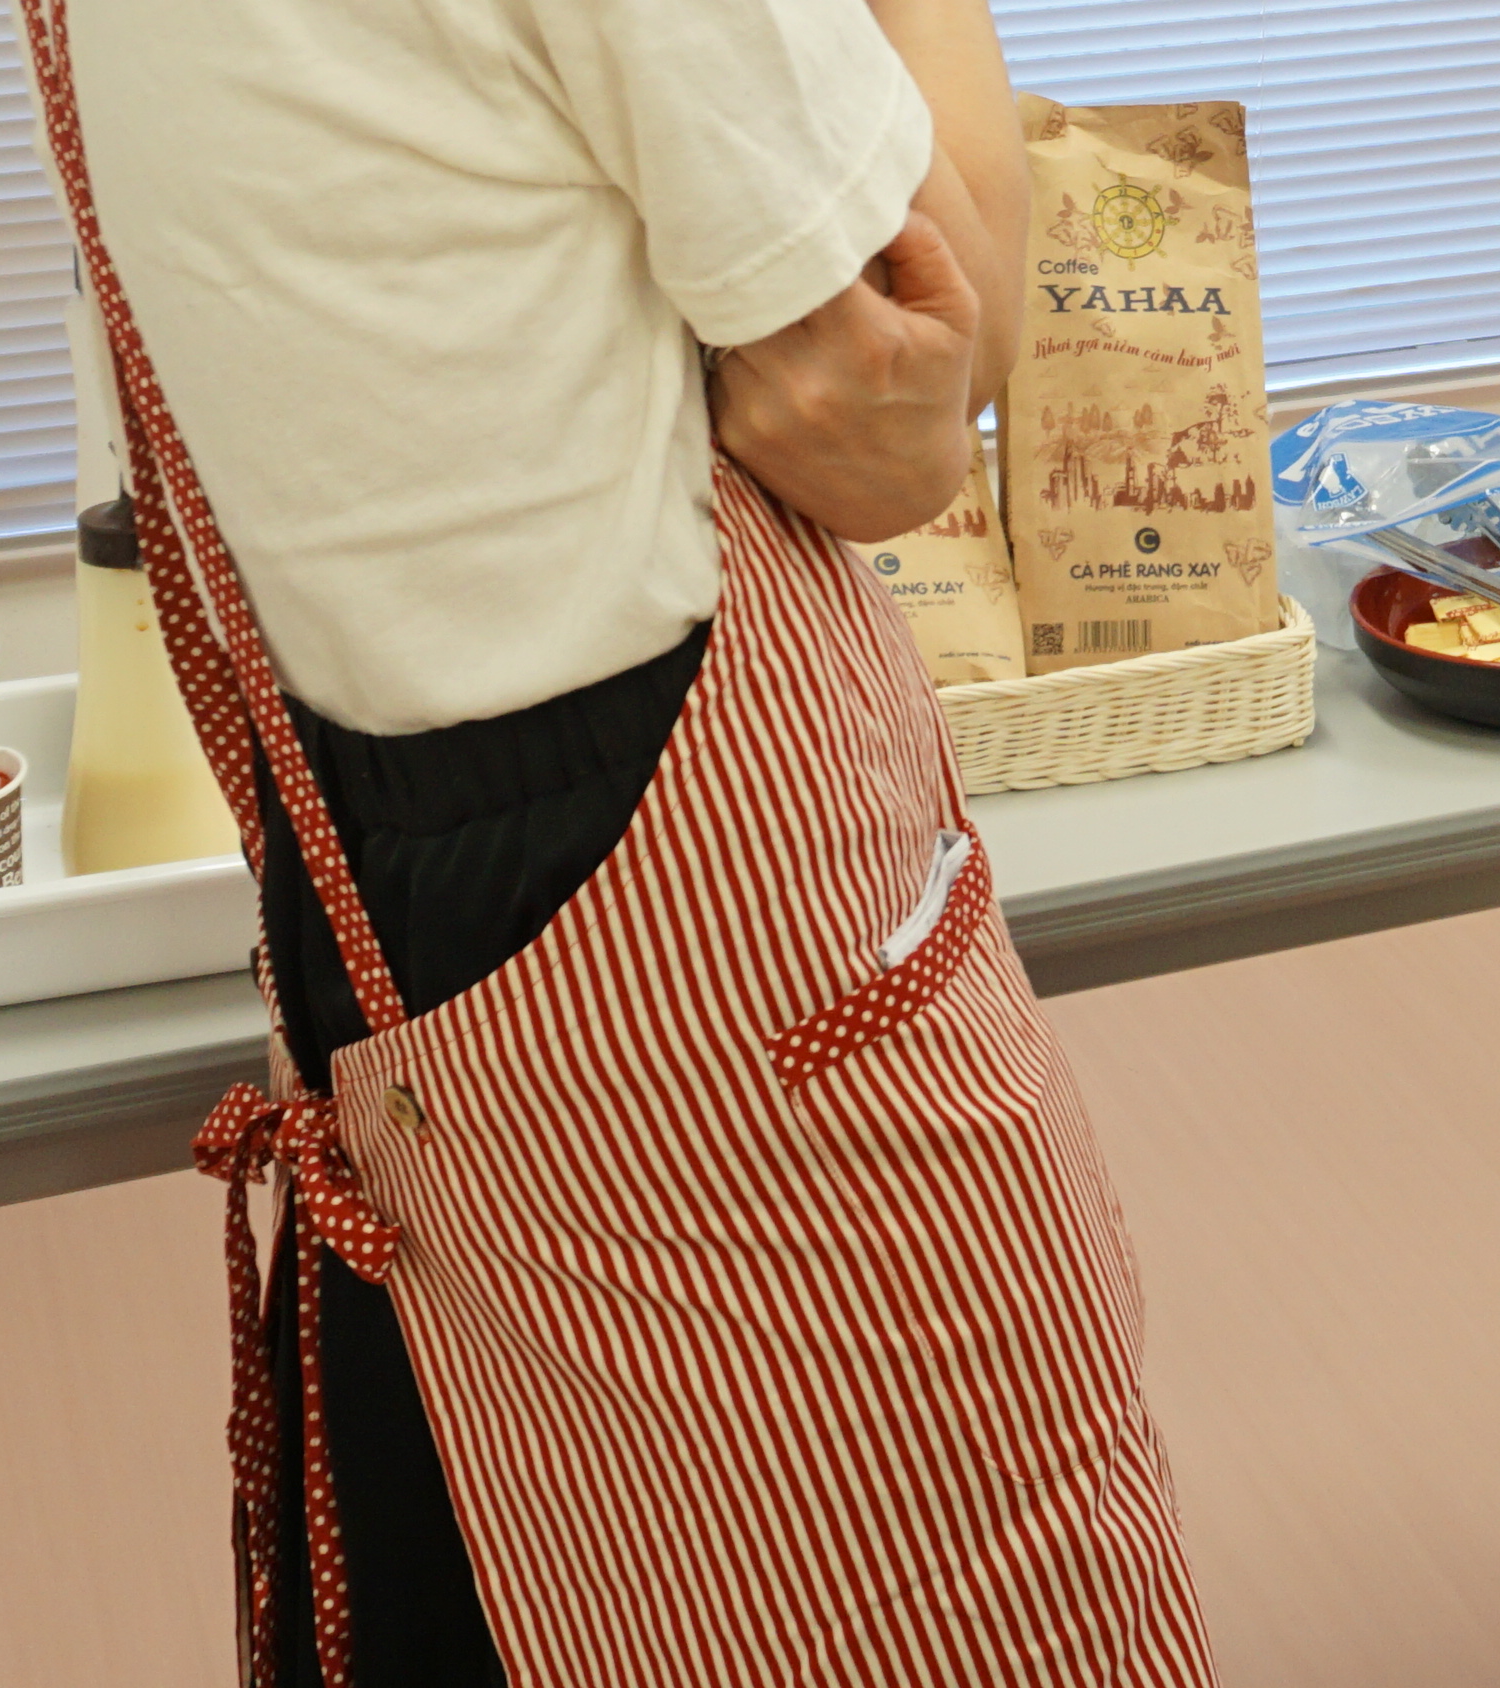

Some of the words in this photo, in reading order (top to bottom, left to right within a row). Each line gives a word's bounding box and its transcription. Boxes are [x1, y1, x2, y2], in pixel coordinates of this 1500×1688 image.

[1038, 259, 1099, 275] Coffee
[1037, 284, 1231, 315] YAHAA
[1099, 560, 1131, 578] PHÊ
[1136, 562, 1183, 578] RANG
[1188, 562, 1221, 578] XAY
[887, 581, 929, 596] ANG
[933, 581, 964, 594] XAY
